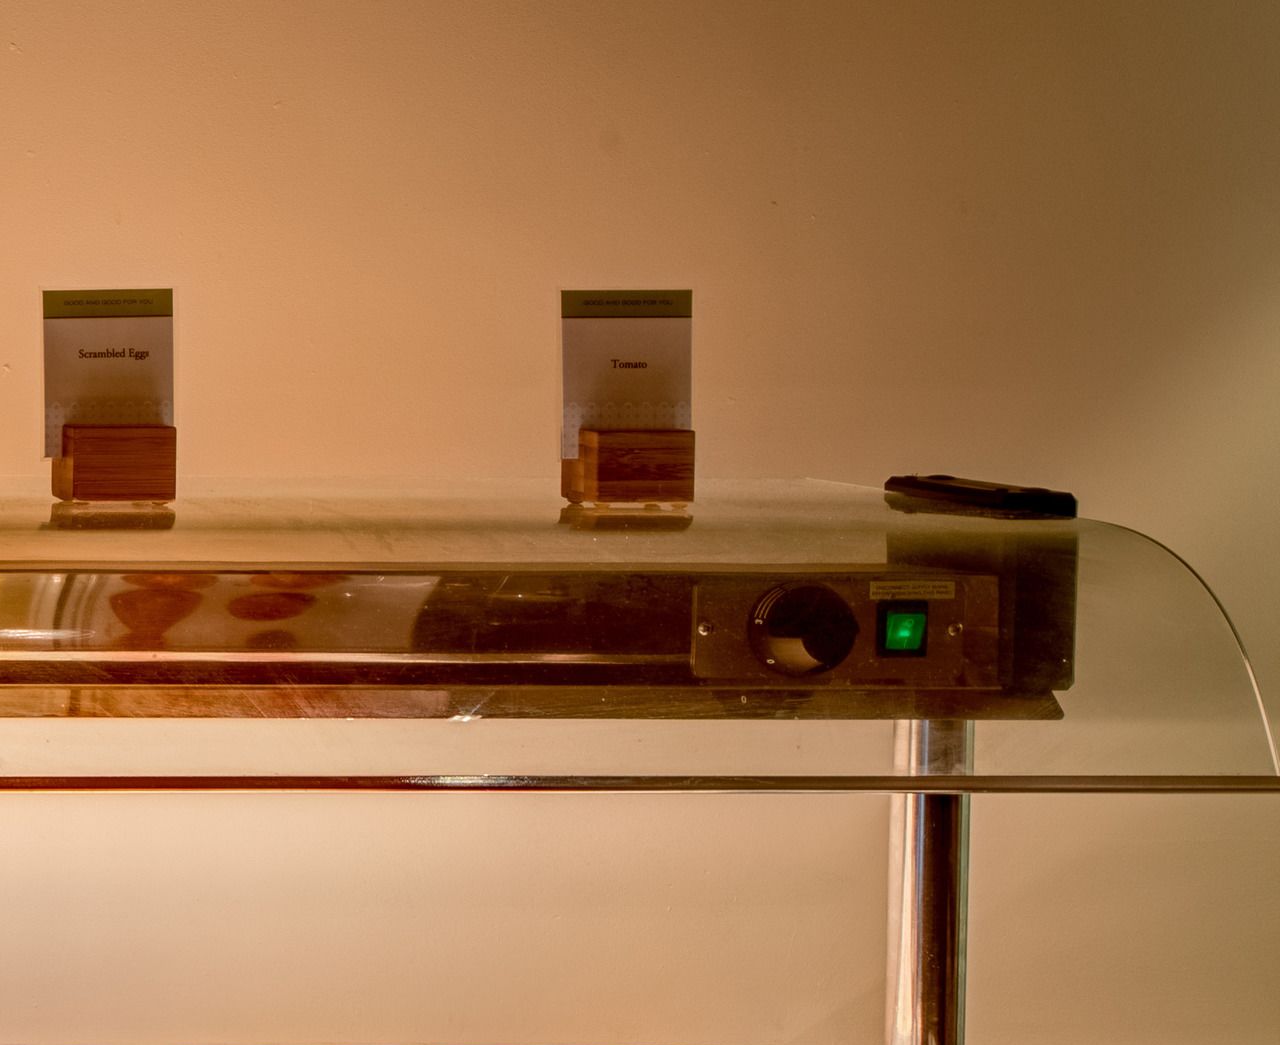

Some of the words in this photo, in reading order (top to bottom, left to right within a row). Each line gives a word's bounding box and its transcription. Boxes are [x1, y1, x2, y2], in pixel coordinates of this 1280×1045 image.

[78, 348, 126, 359] Scrambled
[128, 348, 150, 360] Eggs
[610, 359, 647, 369] Tomato
